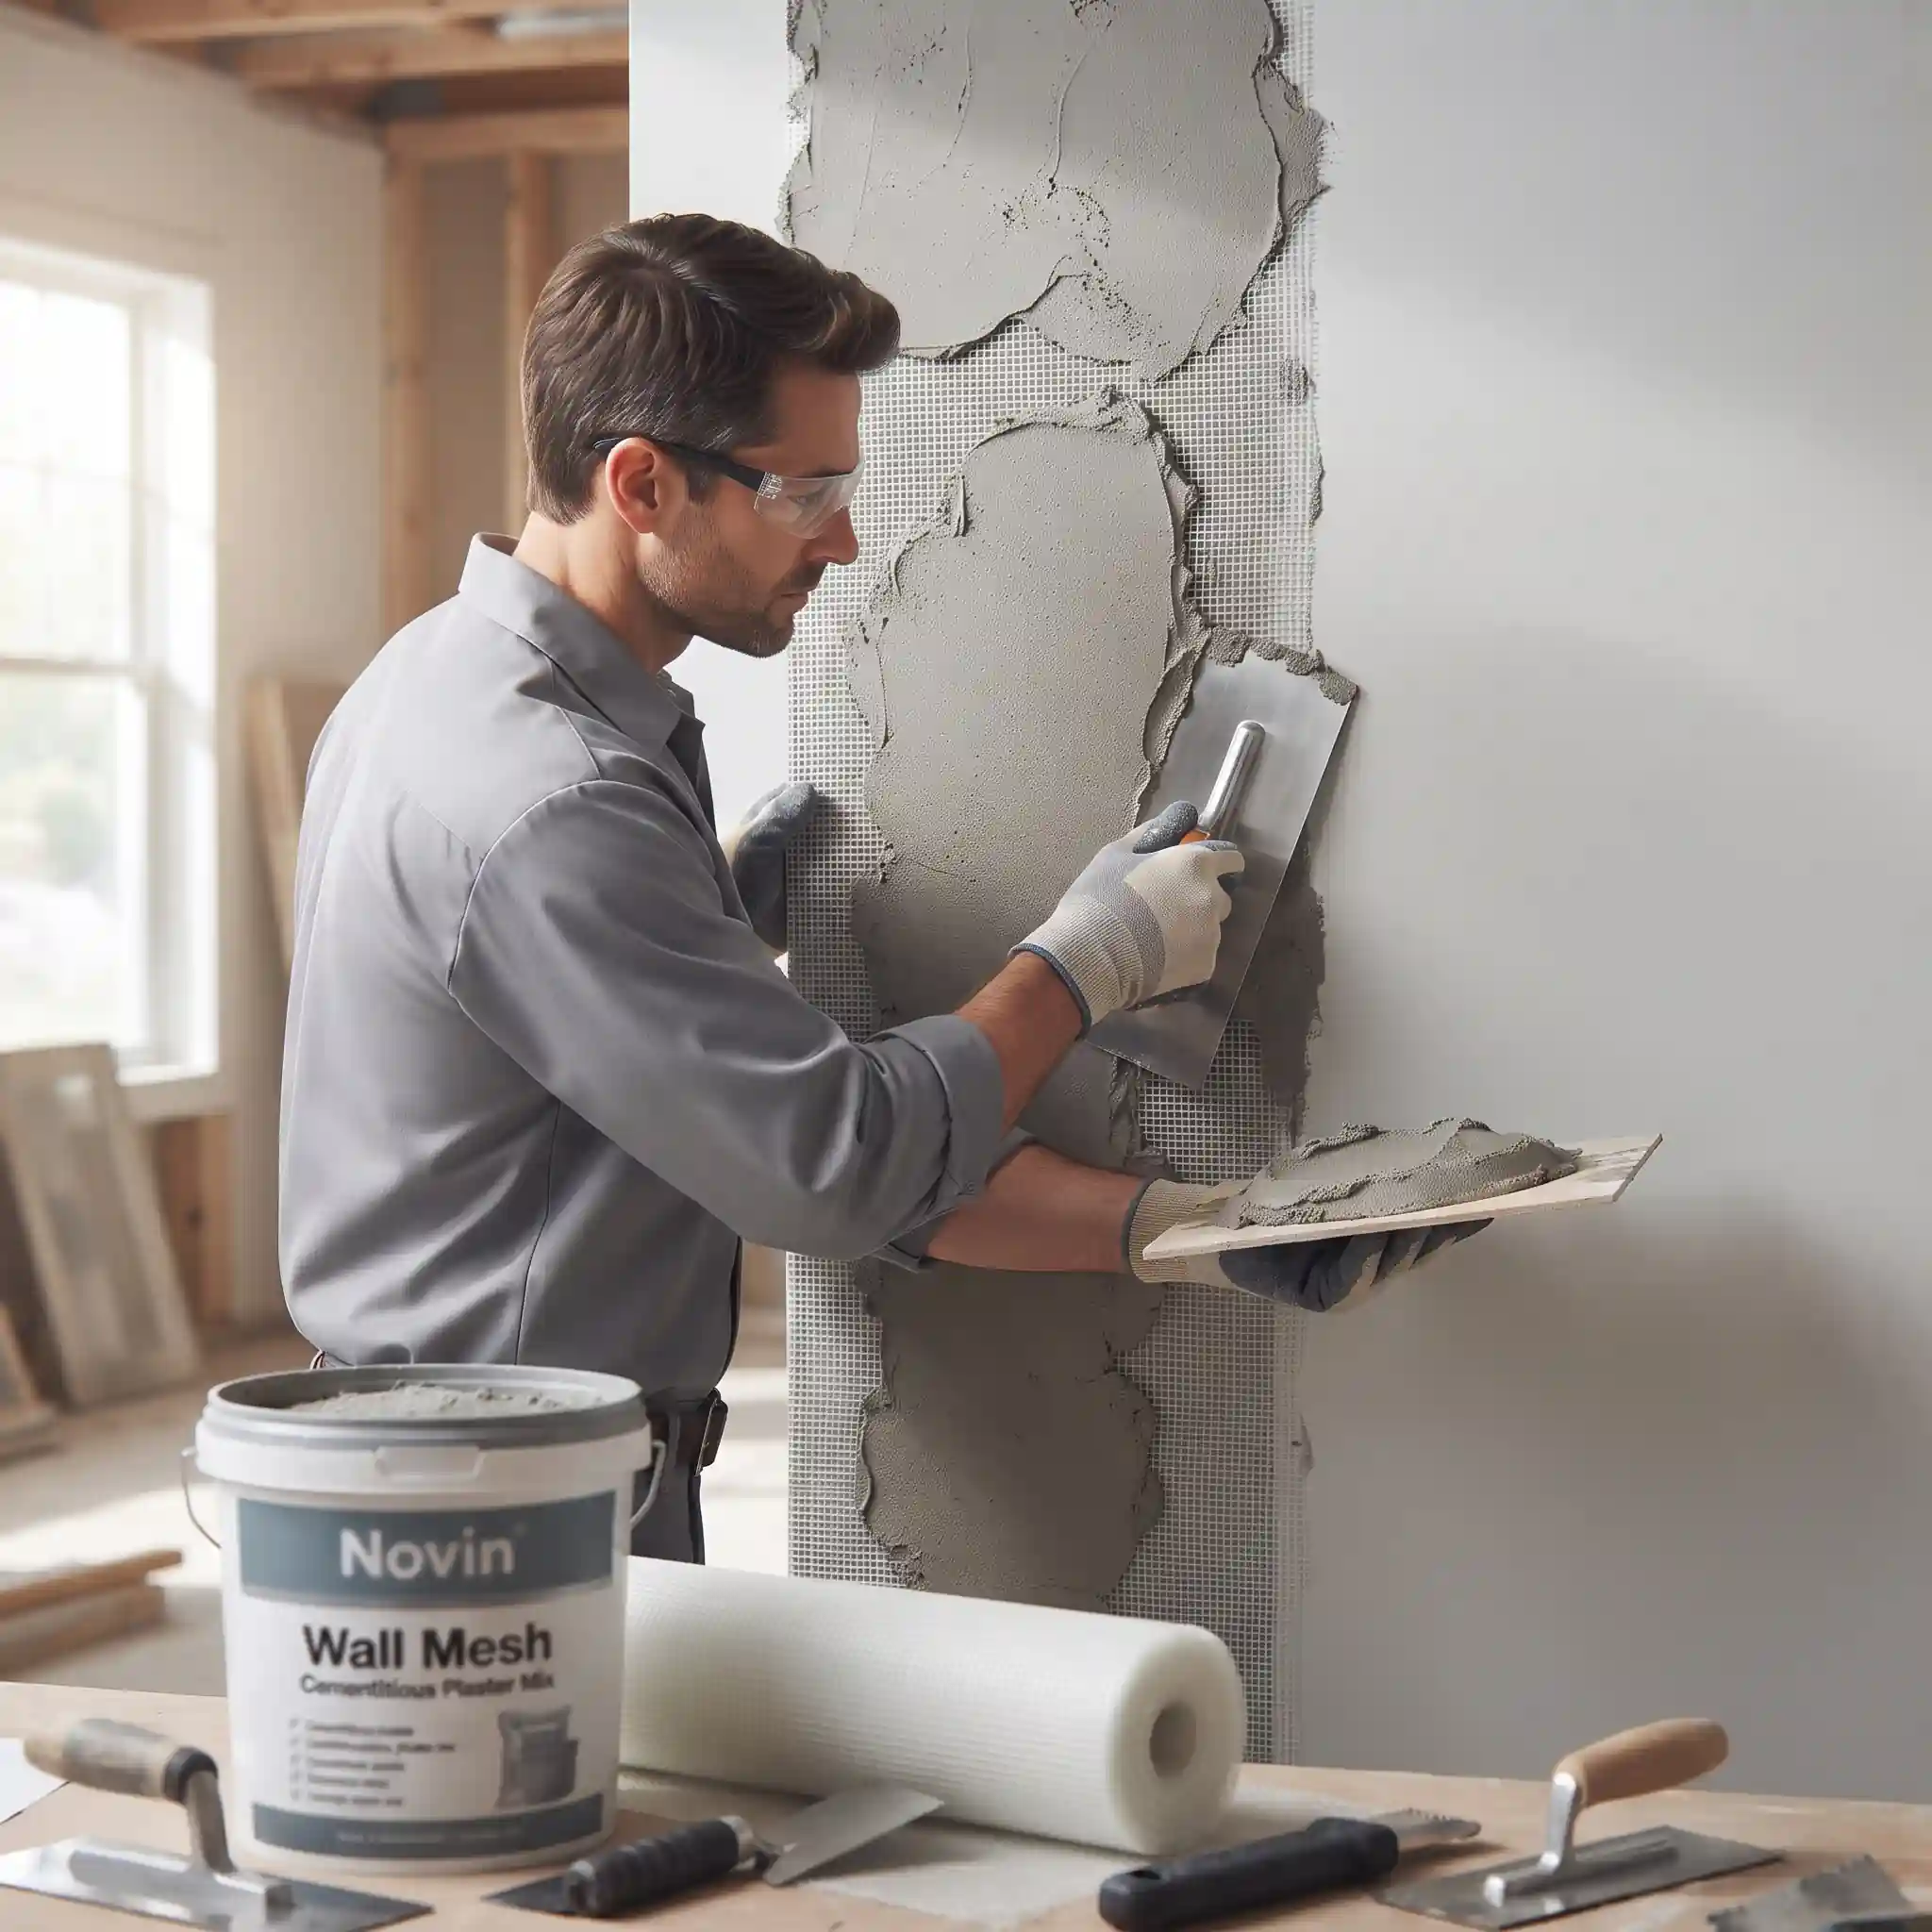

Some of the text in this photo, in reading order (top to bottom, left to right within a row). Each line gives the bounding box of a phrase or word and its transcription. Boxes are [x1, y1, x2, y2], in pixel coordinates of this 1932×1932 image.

[340, 1525, 516, 1580] Novin
[302, 1622, 554, 1670] Wall Mesh
[521, 1671, 556, 1691] Mix
